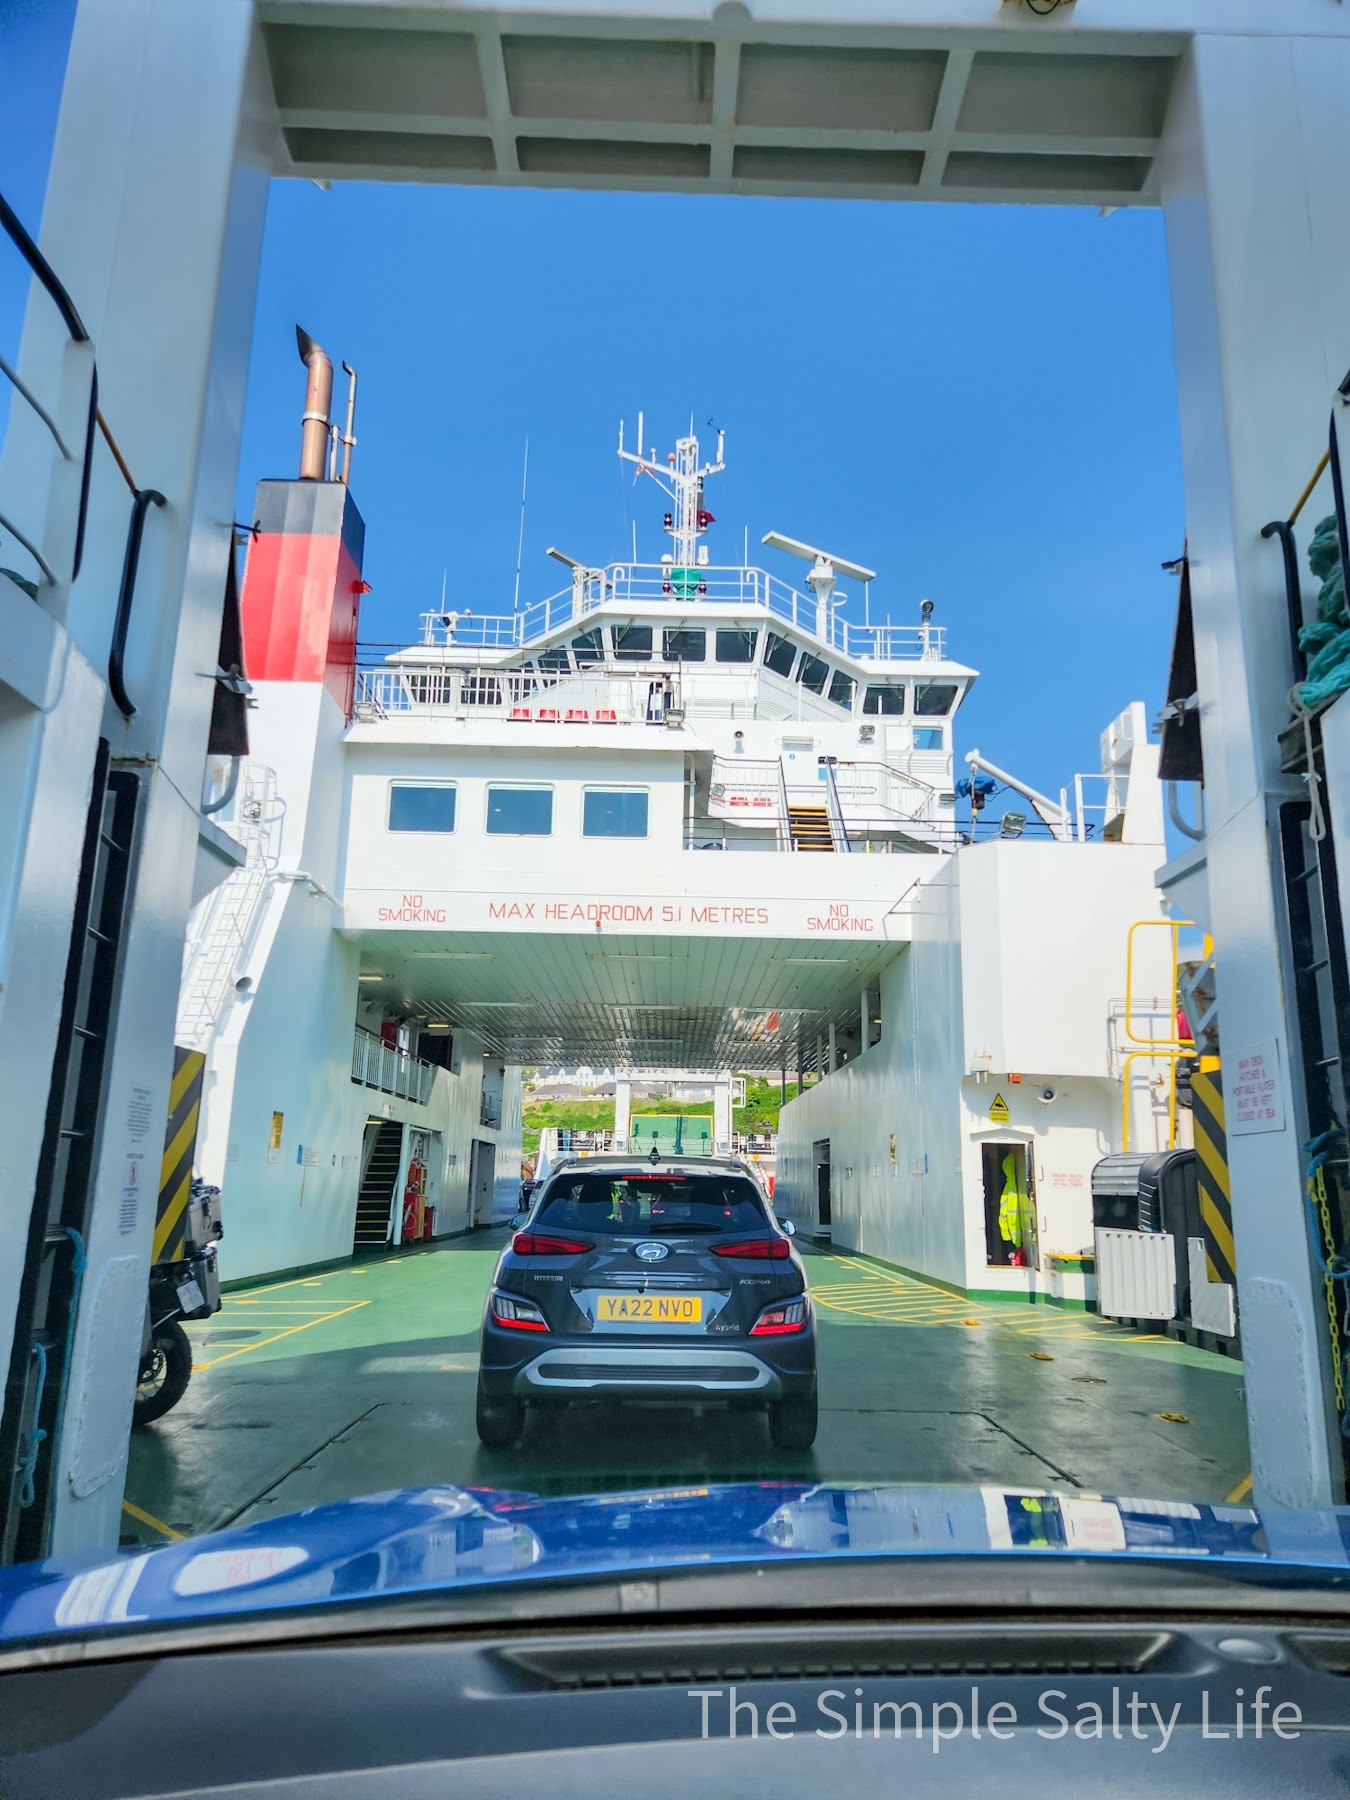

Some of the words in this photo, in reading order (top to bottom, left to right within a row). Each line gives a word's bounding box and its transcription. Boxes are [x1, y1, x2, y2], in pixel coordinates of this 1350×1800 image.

[402, 895, 423, 908] NO
[378, 908, 446, 923] SMOKING
[488, 902, 536, 919] MAX
[545, 903, 653, 922] HEADROOM
[662, 906, 682, 923] 5.1
[690, 907, 768, 924] METRES
[829, 904, 849, 917] NO
[807, 917, 874, 932] SMOKING
[607, 1299, 653, 1316] YA22
[658, 1299, 693, 1317] NVO
